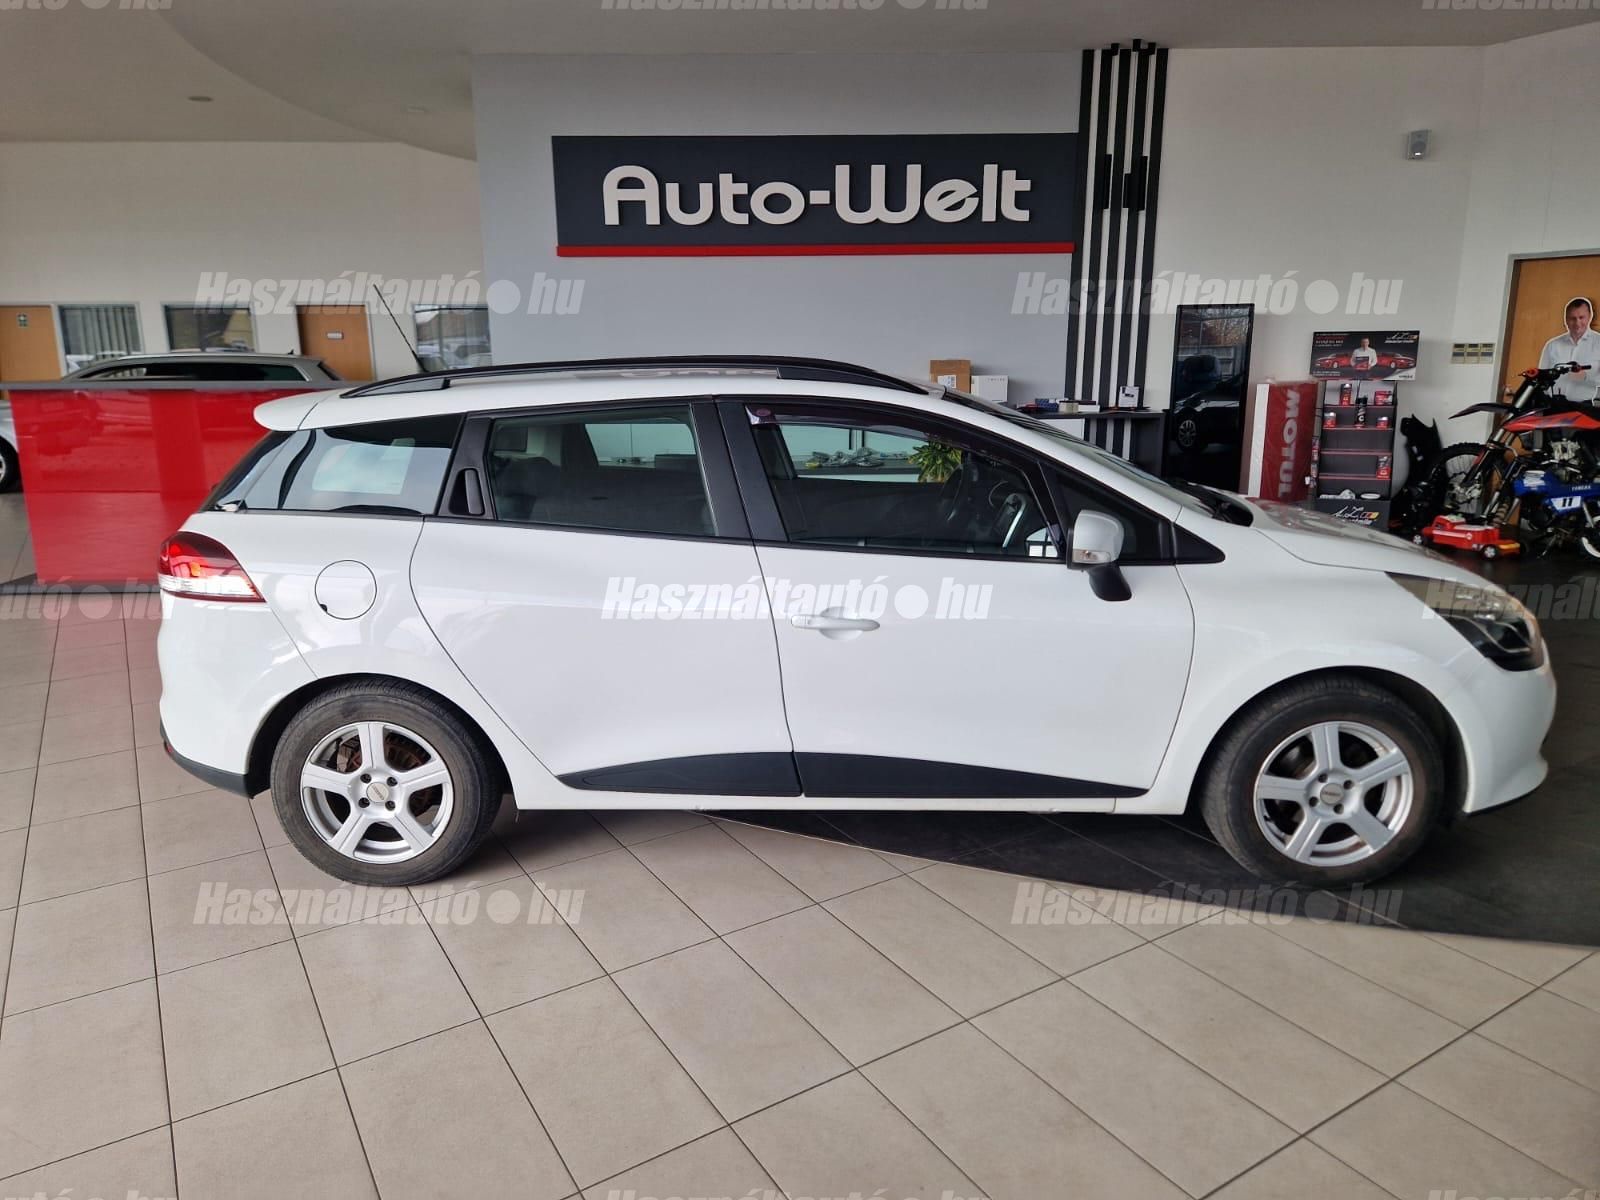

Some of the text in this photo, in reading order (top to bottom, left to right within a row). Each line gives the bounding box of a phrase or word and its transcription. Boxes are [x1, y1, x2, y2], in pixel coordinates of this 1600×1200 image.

[602, 164, 1031, 226] Auto-Welt
[1277, 389, 1301, 498] MOTUL
[1561, 497, 1574, 508] 11
